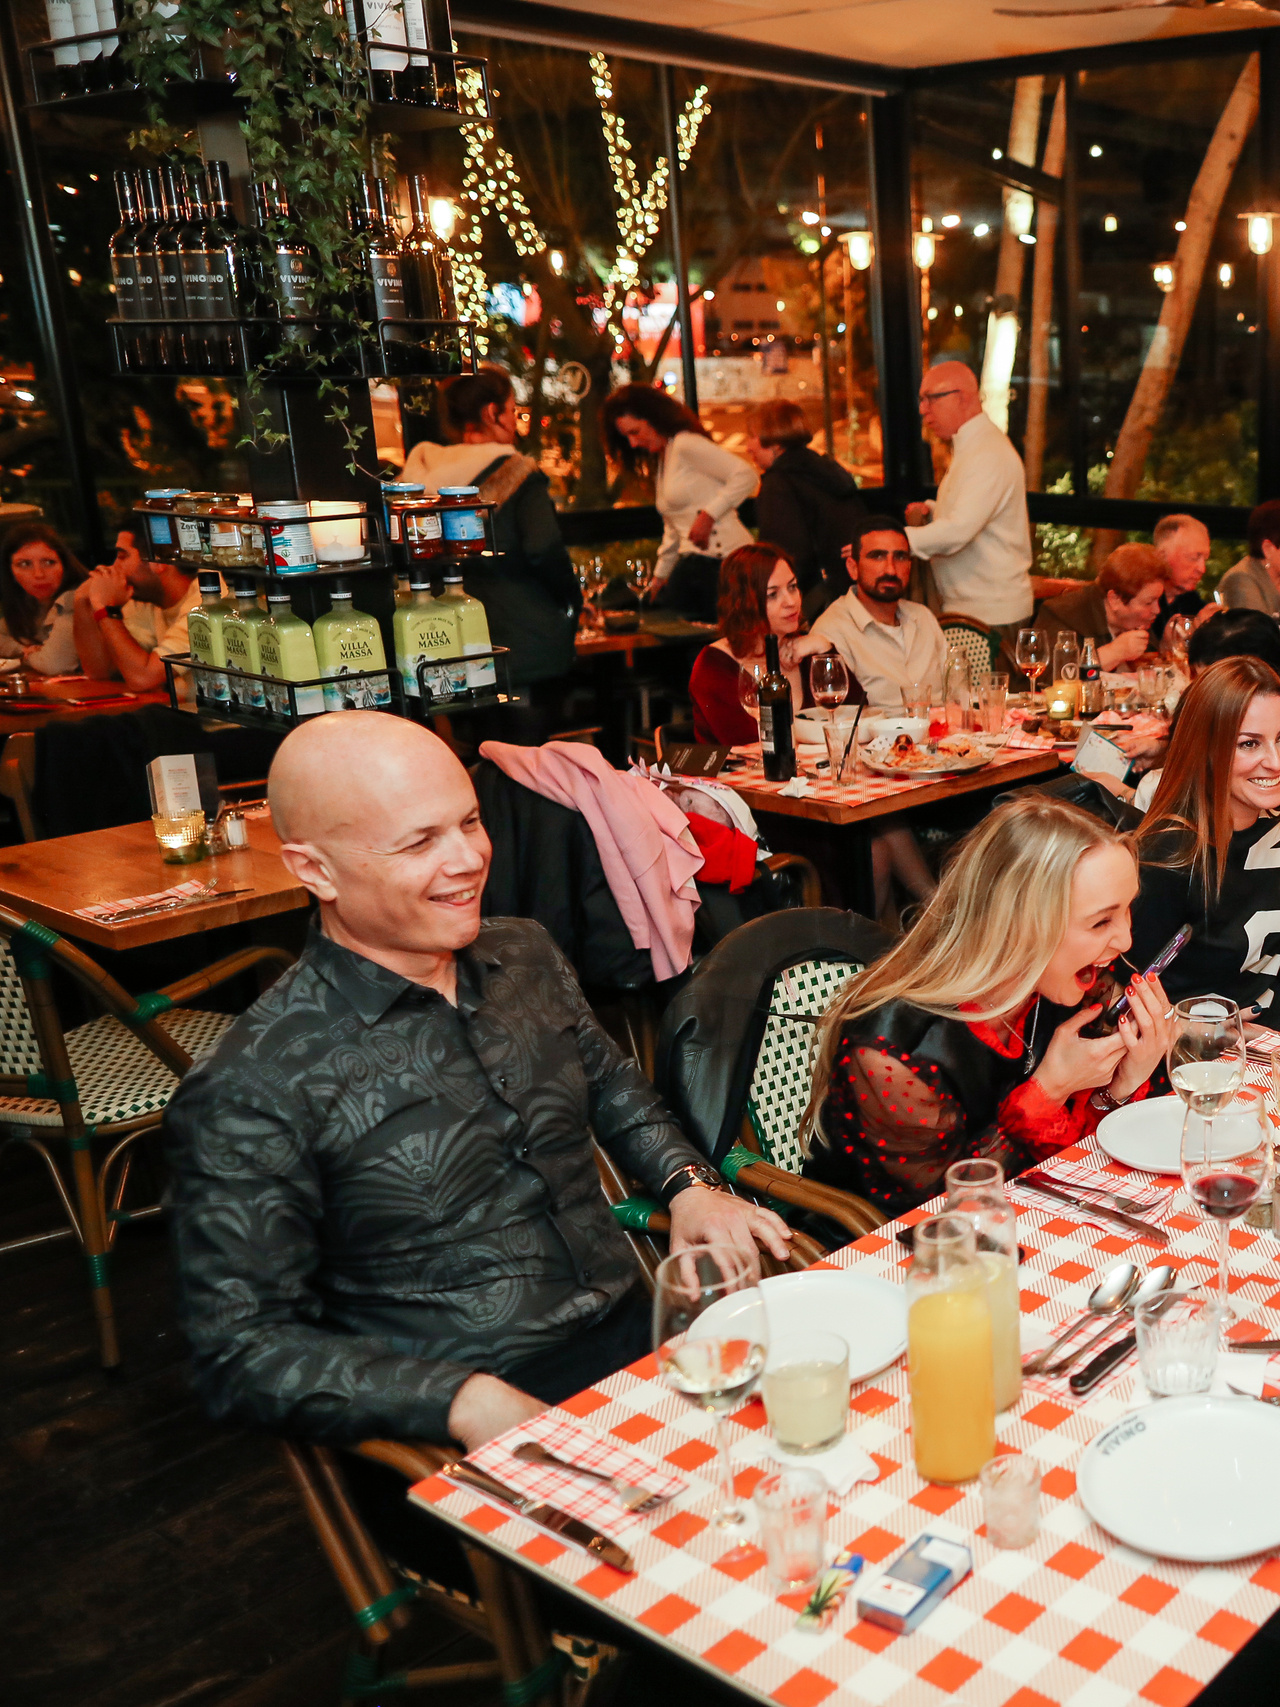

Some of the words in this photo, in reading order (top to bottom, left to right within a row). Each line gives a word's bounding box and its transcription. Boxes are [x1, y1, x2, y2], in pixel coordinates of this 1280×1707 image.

[376, 278, 402, 287] VIVIN
[419, 630, 447, 640] VILLA
[226, 638, 245, 648] VILLA
[341, 641, 369, 651] VILLA
[418, 637, 451, 648] MASSA
[226, 645, 247, 656] MASSA
[261, 644, 276, 655] VILLA
[340, 648, 373, 660] MASSA
[261, 652, 278, 663] MASSA
[1101, 1421, 1147, 1456] VIVINO
